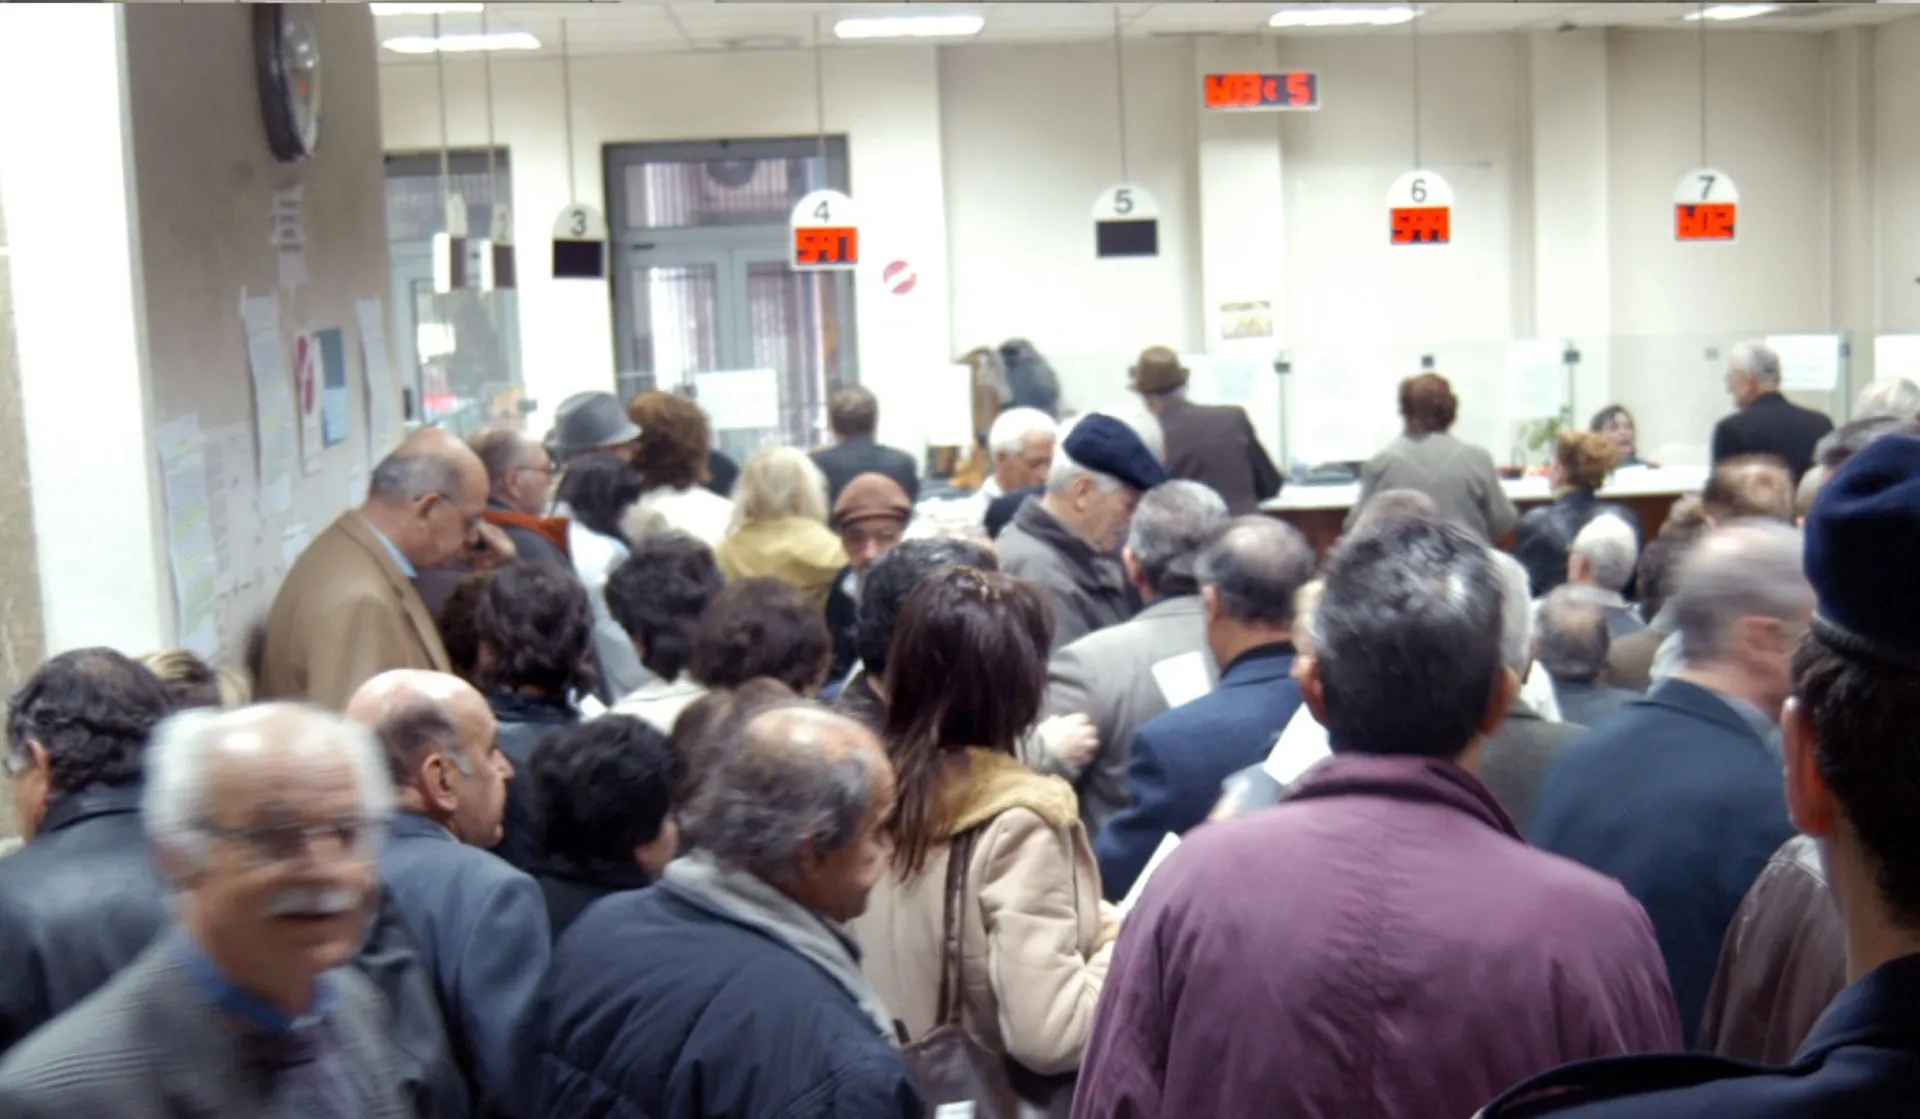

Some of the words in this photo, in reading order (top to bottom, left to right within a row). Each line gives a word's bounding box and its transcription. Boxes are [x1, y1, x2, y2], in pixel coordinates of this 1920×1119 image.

[1285, 71, 1311, 107] 5
[1113, 188, 1134, 214] 5
[1411, 178, 1427, 203] 6
[1698, 175, 1716, 200] 7
[569, 209, 588, 237] 3
[813, 199, 831, 223] 4
[1675, 203, 1735, 240] 602
[1390, 207, 1450, 244] 599
